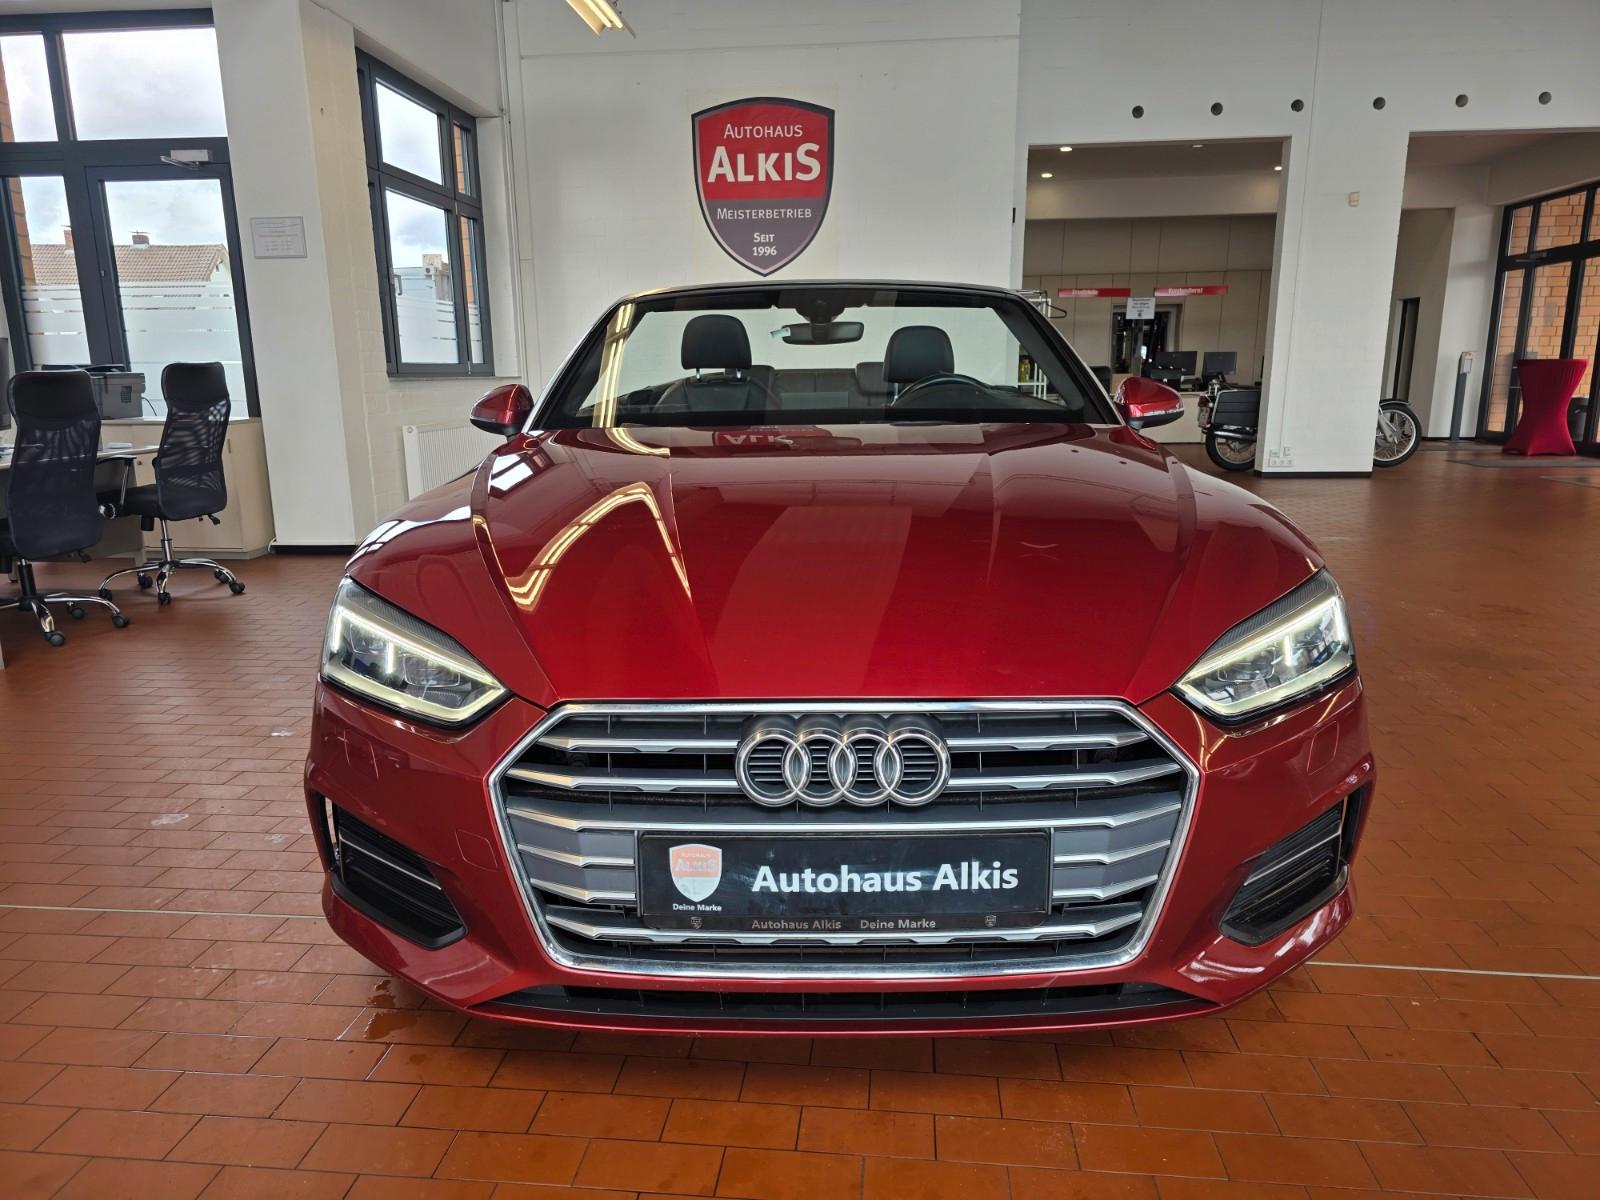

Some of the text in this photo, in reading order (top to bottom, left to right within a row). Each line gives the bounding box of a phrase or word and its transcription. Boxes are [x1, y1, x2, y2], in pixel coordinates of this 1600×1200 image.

[723, 123, 803, 139] AUTOHAUS
[707, 142, 821, 183] ALKIS
[717, 207, 812, 220] MEISTERBETRIEB
[753, 232, 775, 243] SEIT
[752, 246, 777, 256] 1996
[751, 861, 1019, 893] Autohaus Alkis
[672, 903, 722, 912] Deine Marke
[751, 919, 842, 929] Autohaus Alkis
[860, 918, 936, 929] Deine Marke
